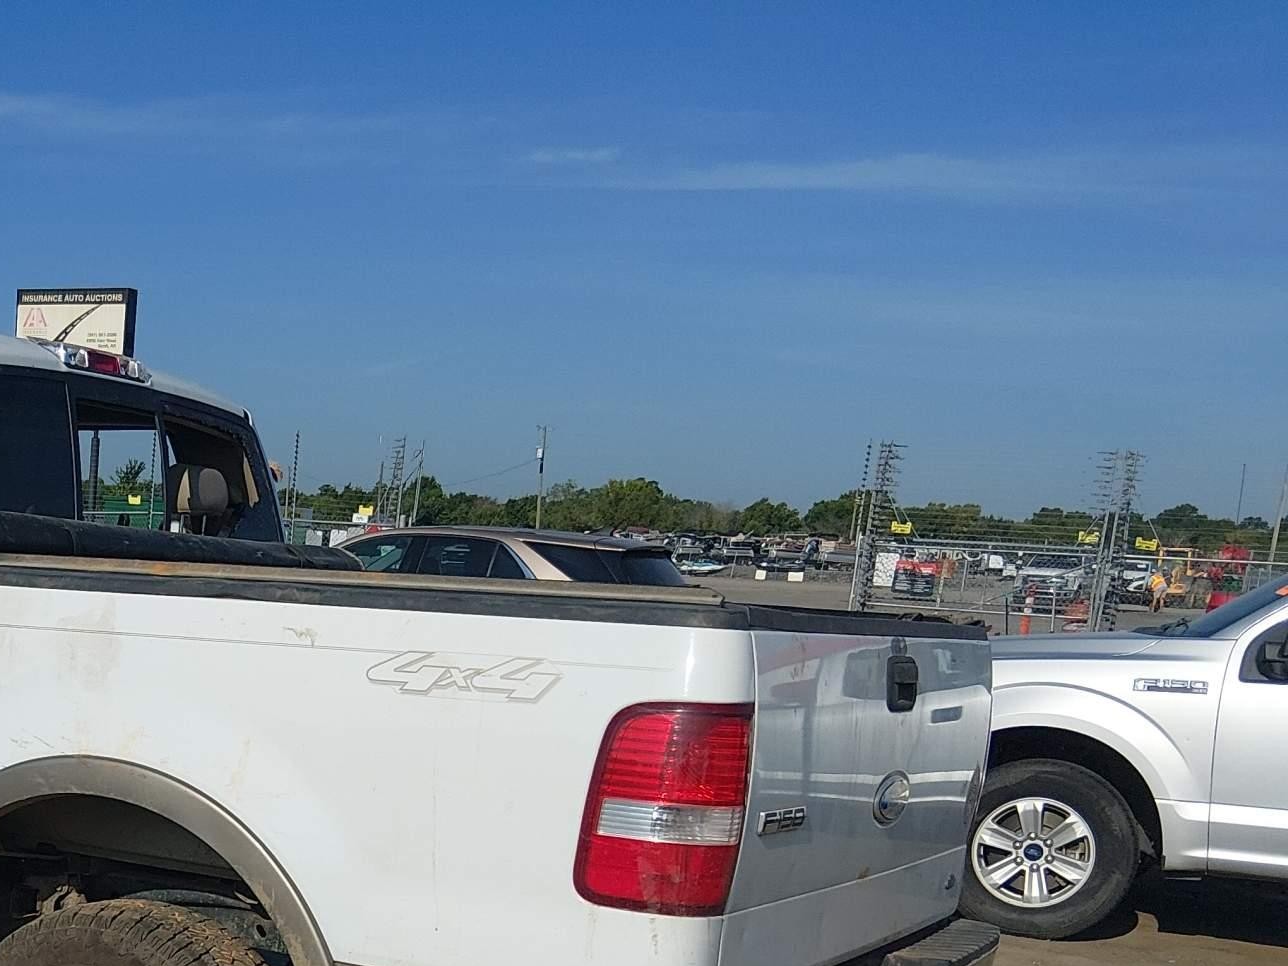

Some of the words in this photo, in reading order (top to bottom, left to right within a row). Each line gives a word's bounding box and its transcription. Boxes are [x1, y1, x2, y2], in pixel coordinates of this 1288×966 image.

[22, 294, 63, 303] INSURANCE
[64, 293, 84, 303] AUTO
[85, 293, 123, 302] AUCTIONS
[366, 651, 563, 703] 4x4
